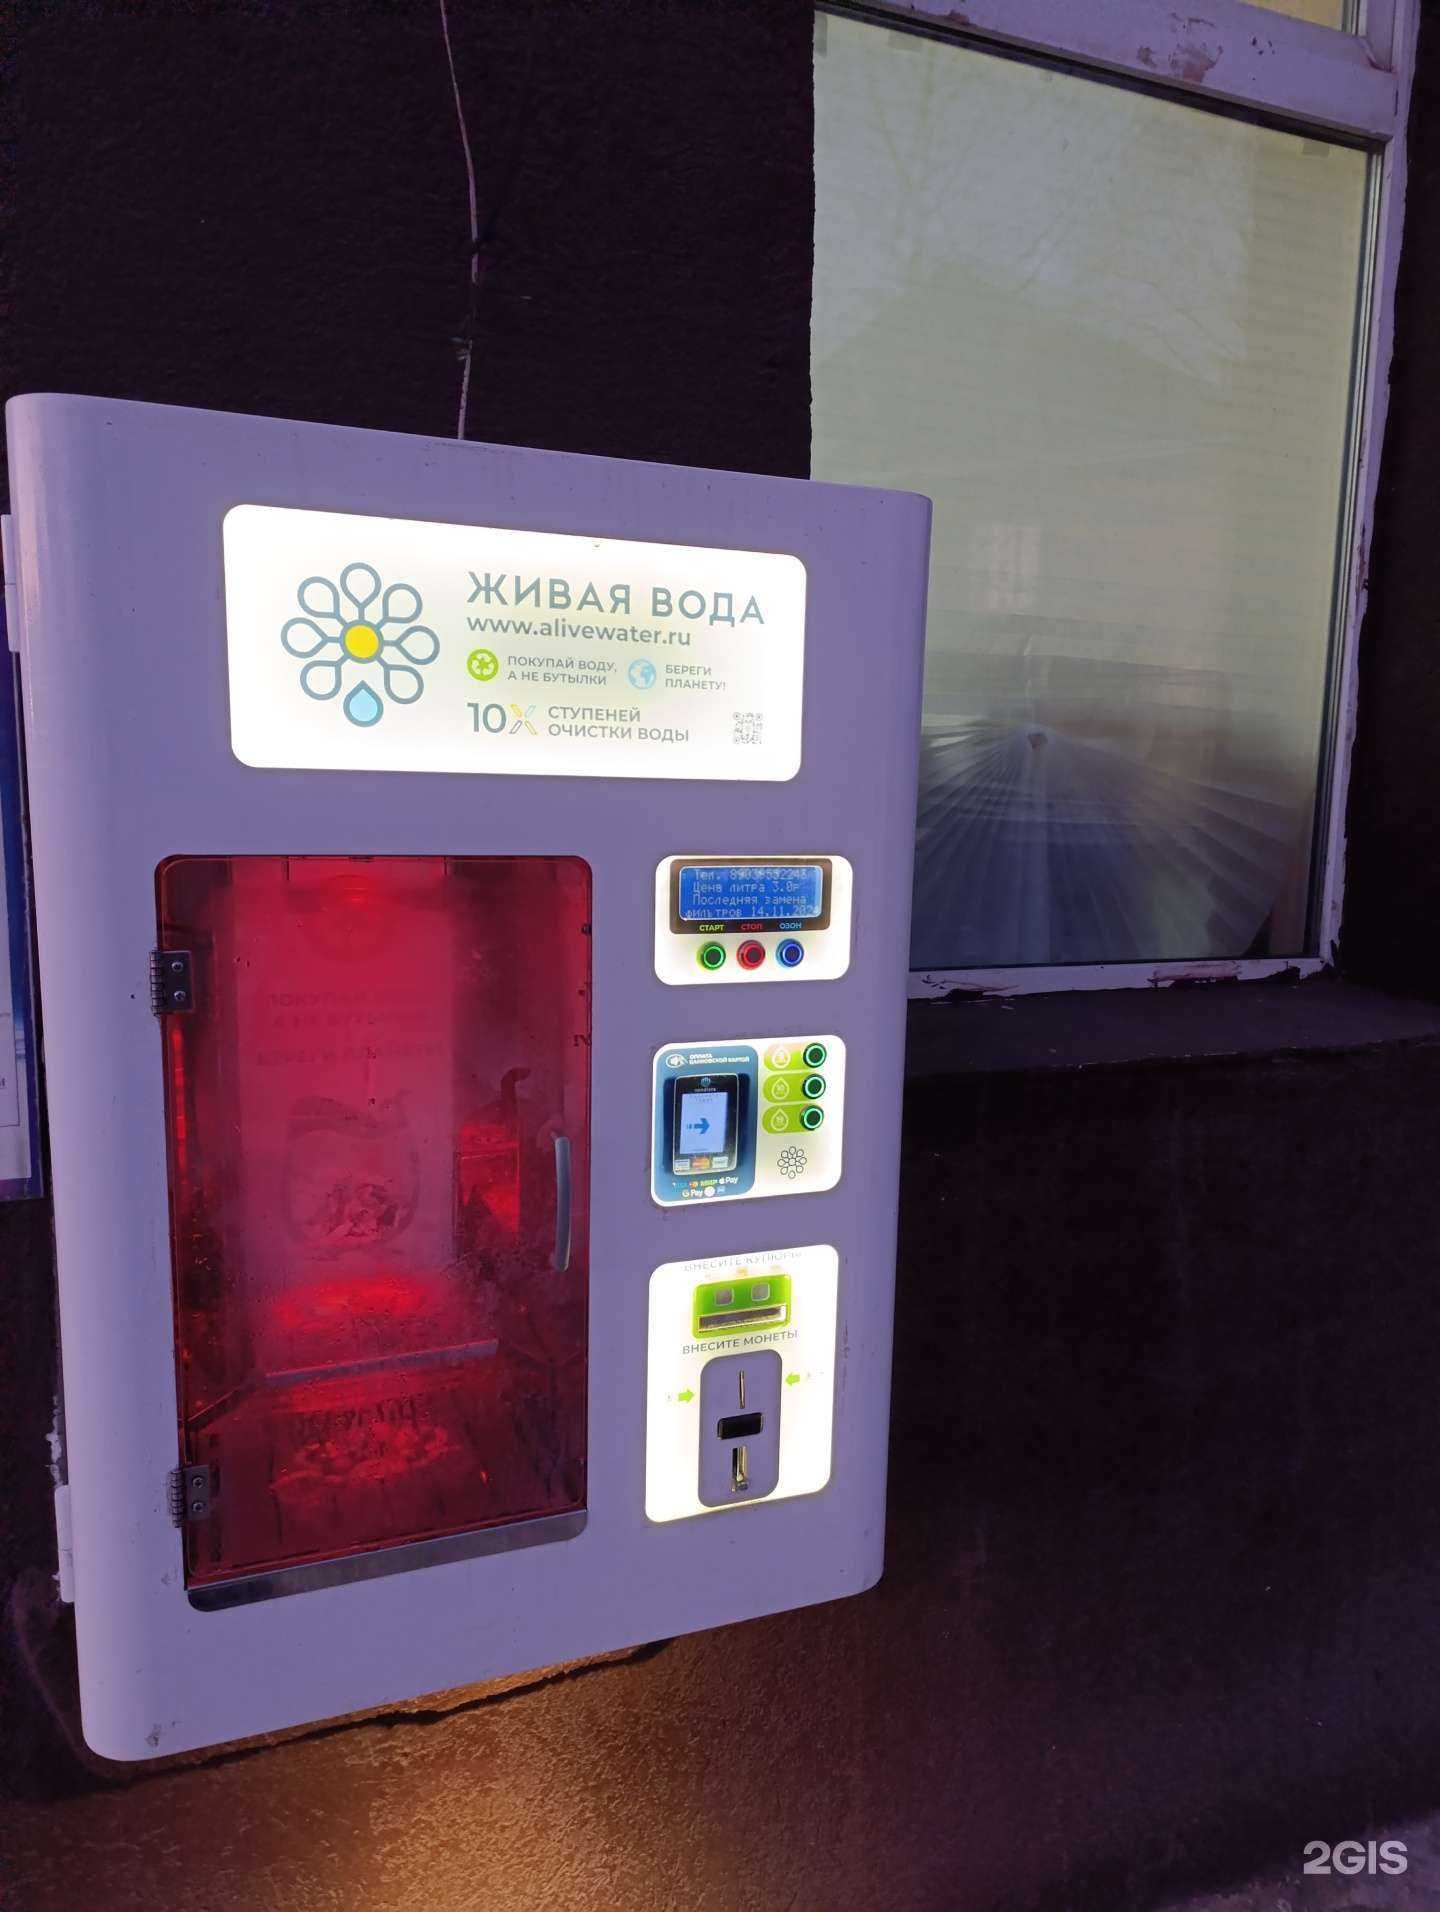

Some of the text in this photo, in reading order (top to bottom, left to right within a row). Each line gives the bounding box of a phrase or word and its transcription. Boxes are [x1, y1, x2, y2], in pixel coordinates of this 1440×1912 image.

[466, 571, 765, 627] ЖИВАЯ ВОДА
[466, 617, 692, 646] www.alivewater.ru
[508, 655, 618, 673] ПОКУПАЙ ВОДУ,
[665, 664, 712, 677] БЕРЕГИ
[507, 670, 607, 686] А НЕ БУТЫЛКИ
[664, 678, 727, 692] ПЛАНЕТУ!
[548, 705, 641, 723] СТУПЕНЕЙ
[548, 723, 690, 744] ОЧИСТКИ ВОДЫ
[729, 883, 766, 893] литра
[692, 893, 808, 906] Последняя замена
[699, 924, 725, 932] СТАРТ
[740, 922, 764, 931] СТОП
[779, 921, 803, 930] ОЗОН
[682, 1330, 798, 1354] ВНЕСИТЕ МОНЕТЫ
